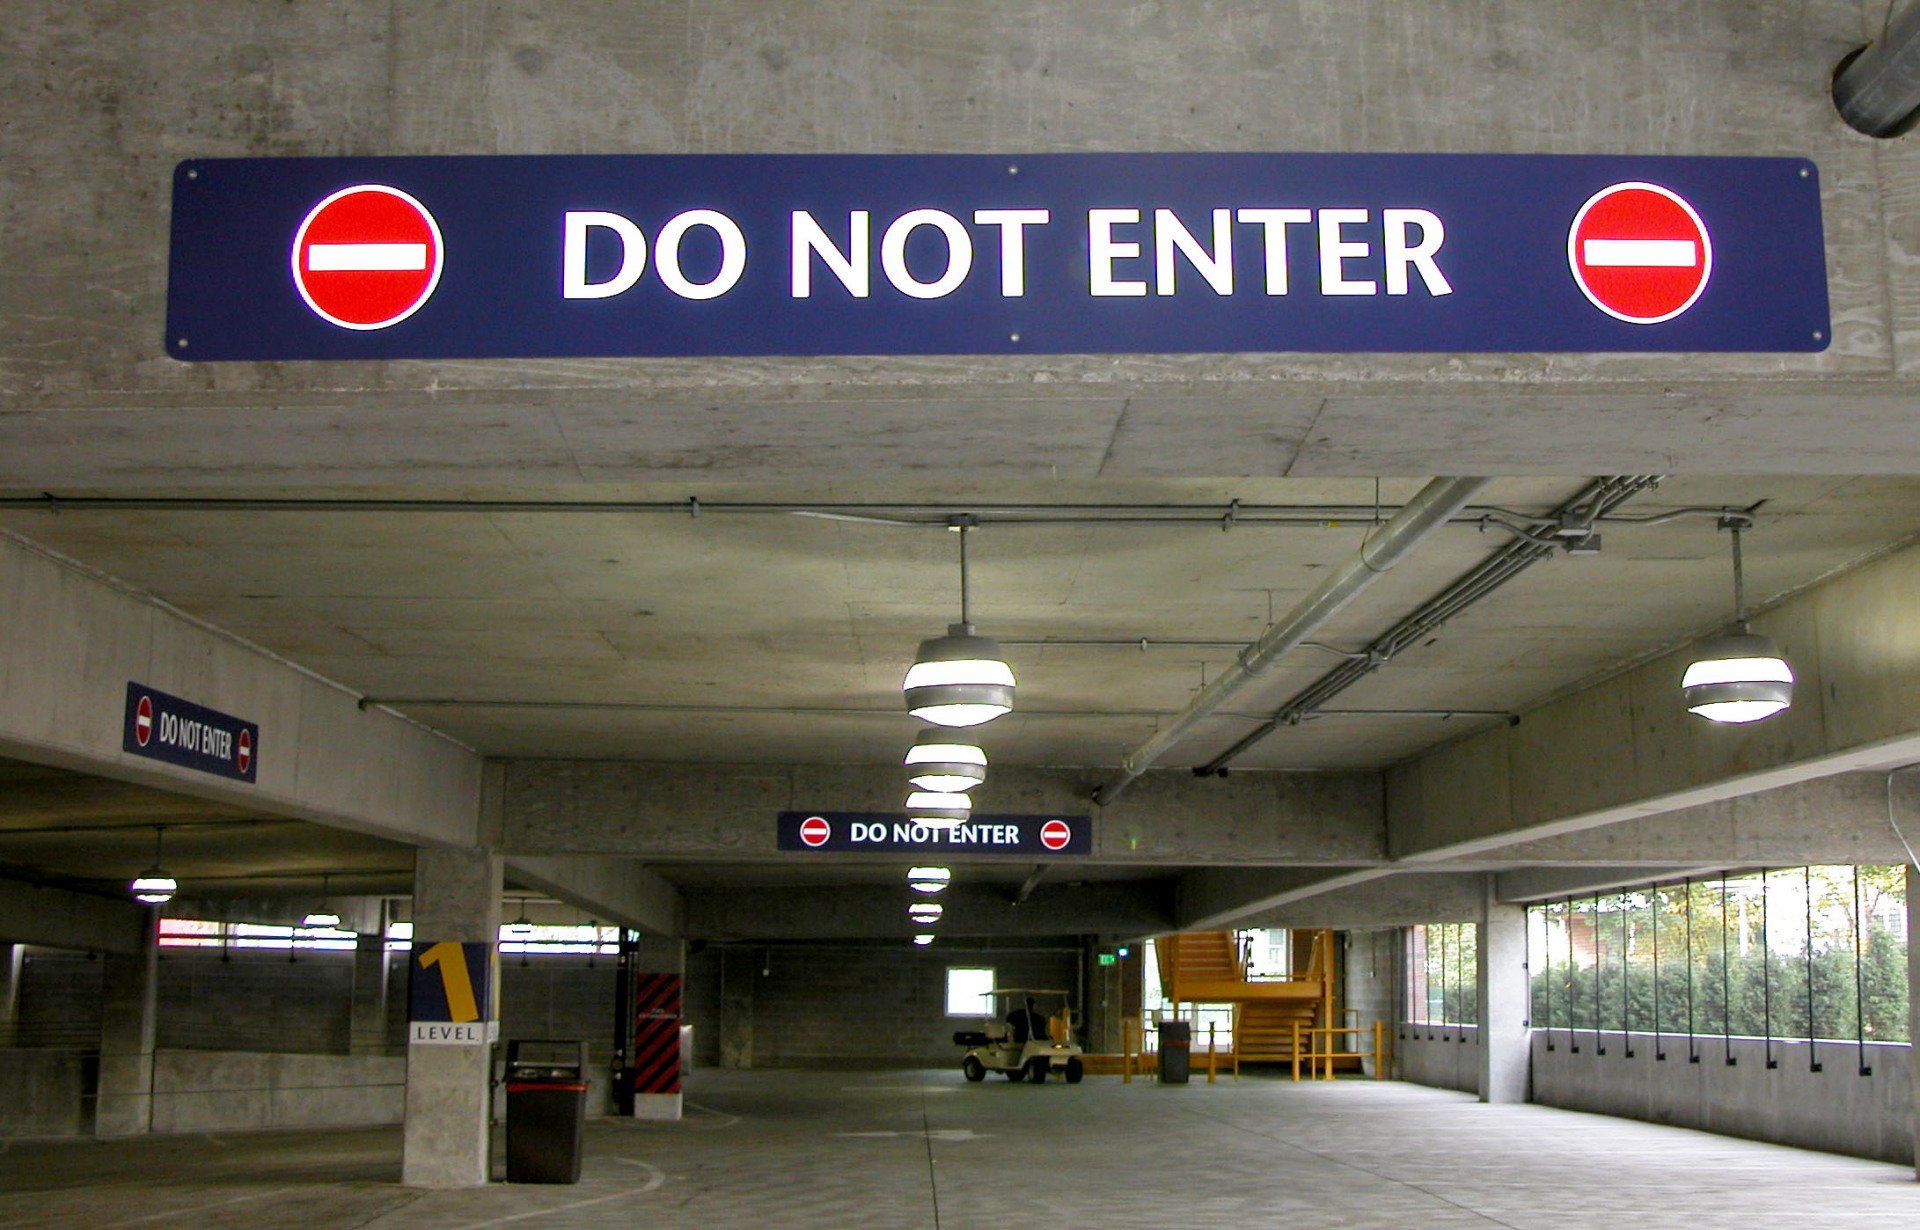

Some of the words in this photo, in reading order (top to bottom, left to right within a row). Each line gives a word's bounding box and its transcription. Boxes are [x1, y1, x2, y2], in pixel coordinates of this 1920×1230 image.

[563, 209, 747, 300] DO
[792, 208, 1050, 298] NOT
[1088, 208, 1453, 297] ENTER
[160, 712, 178, 745] DO
[179, 719, 201, 751] NOT
[202, 725, 232, 760] ENTER
[851, 823, 887, 843] DO
[949, 824, 1019, 844] ENTER
[418, 941, 479, 1023] 1
[418, 1027, 475, 1040] LEVEL
